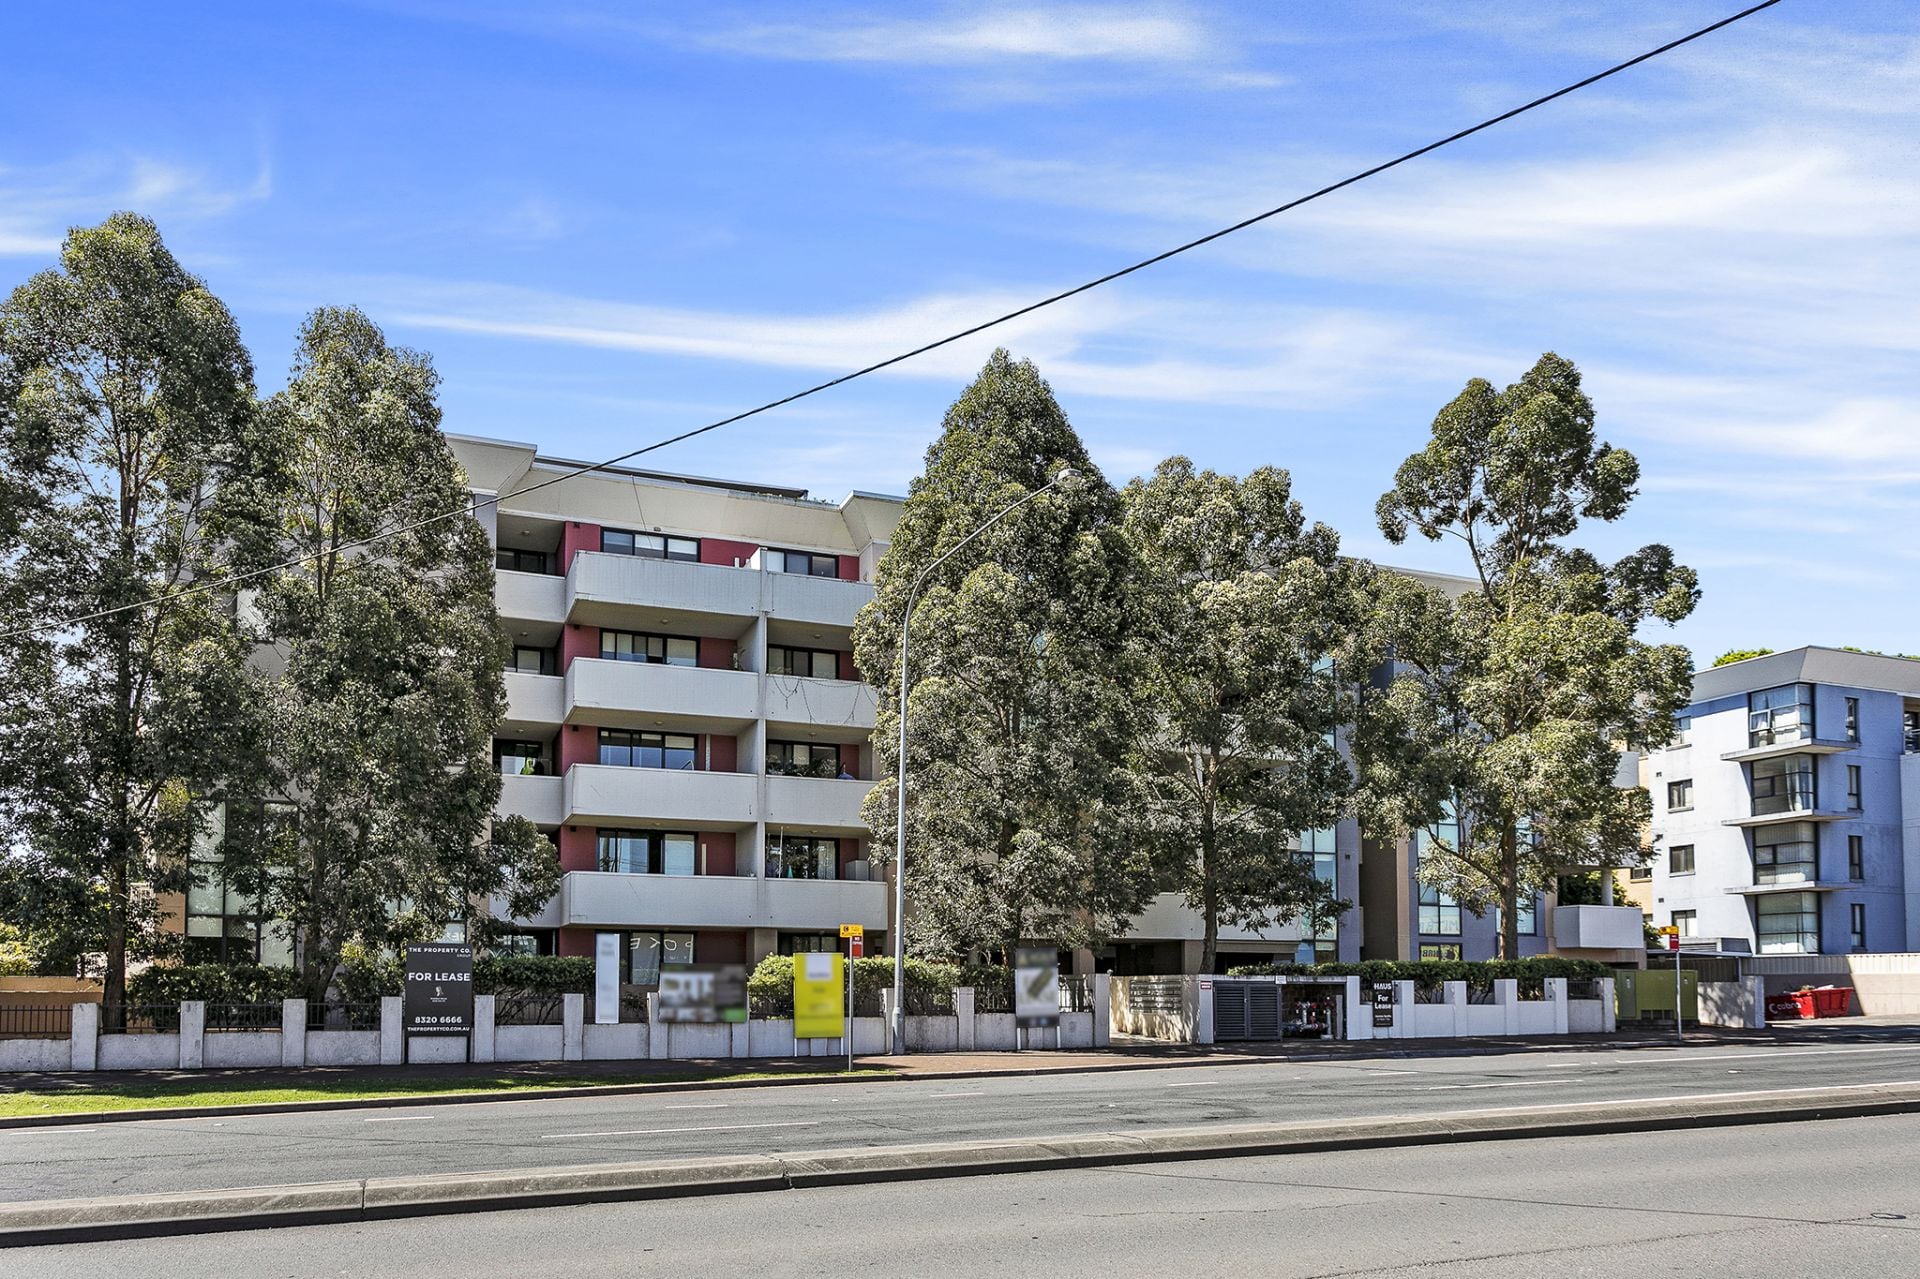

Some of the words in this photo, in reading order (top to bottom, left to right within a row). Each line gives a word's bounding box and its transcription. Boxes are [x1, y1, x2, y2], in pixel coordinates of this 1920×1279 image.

[408, 972, 432, 981] FOR
[435, 972, 471, 981] LEASE
[1377, 994, 1389, 1002] For
